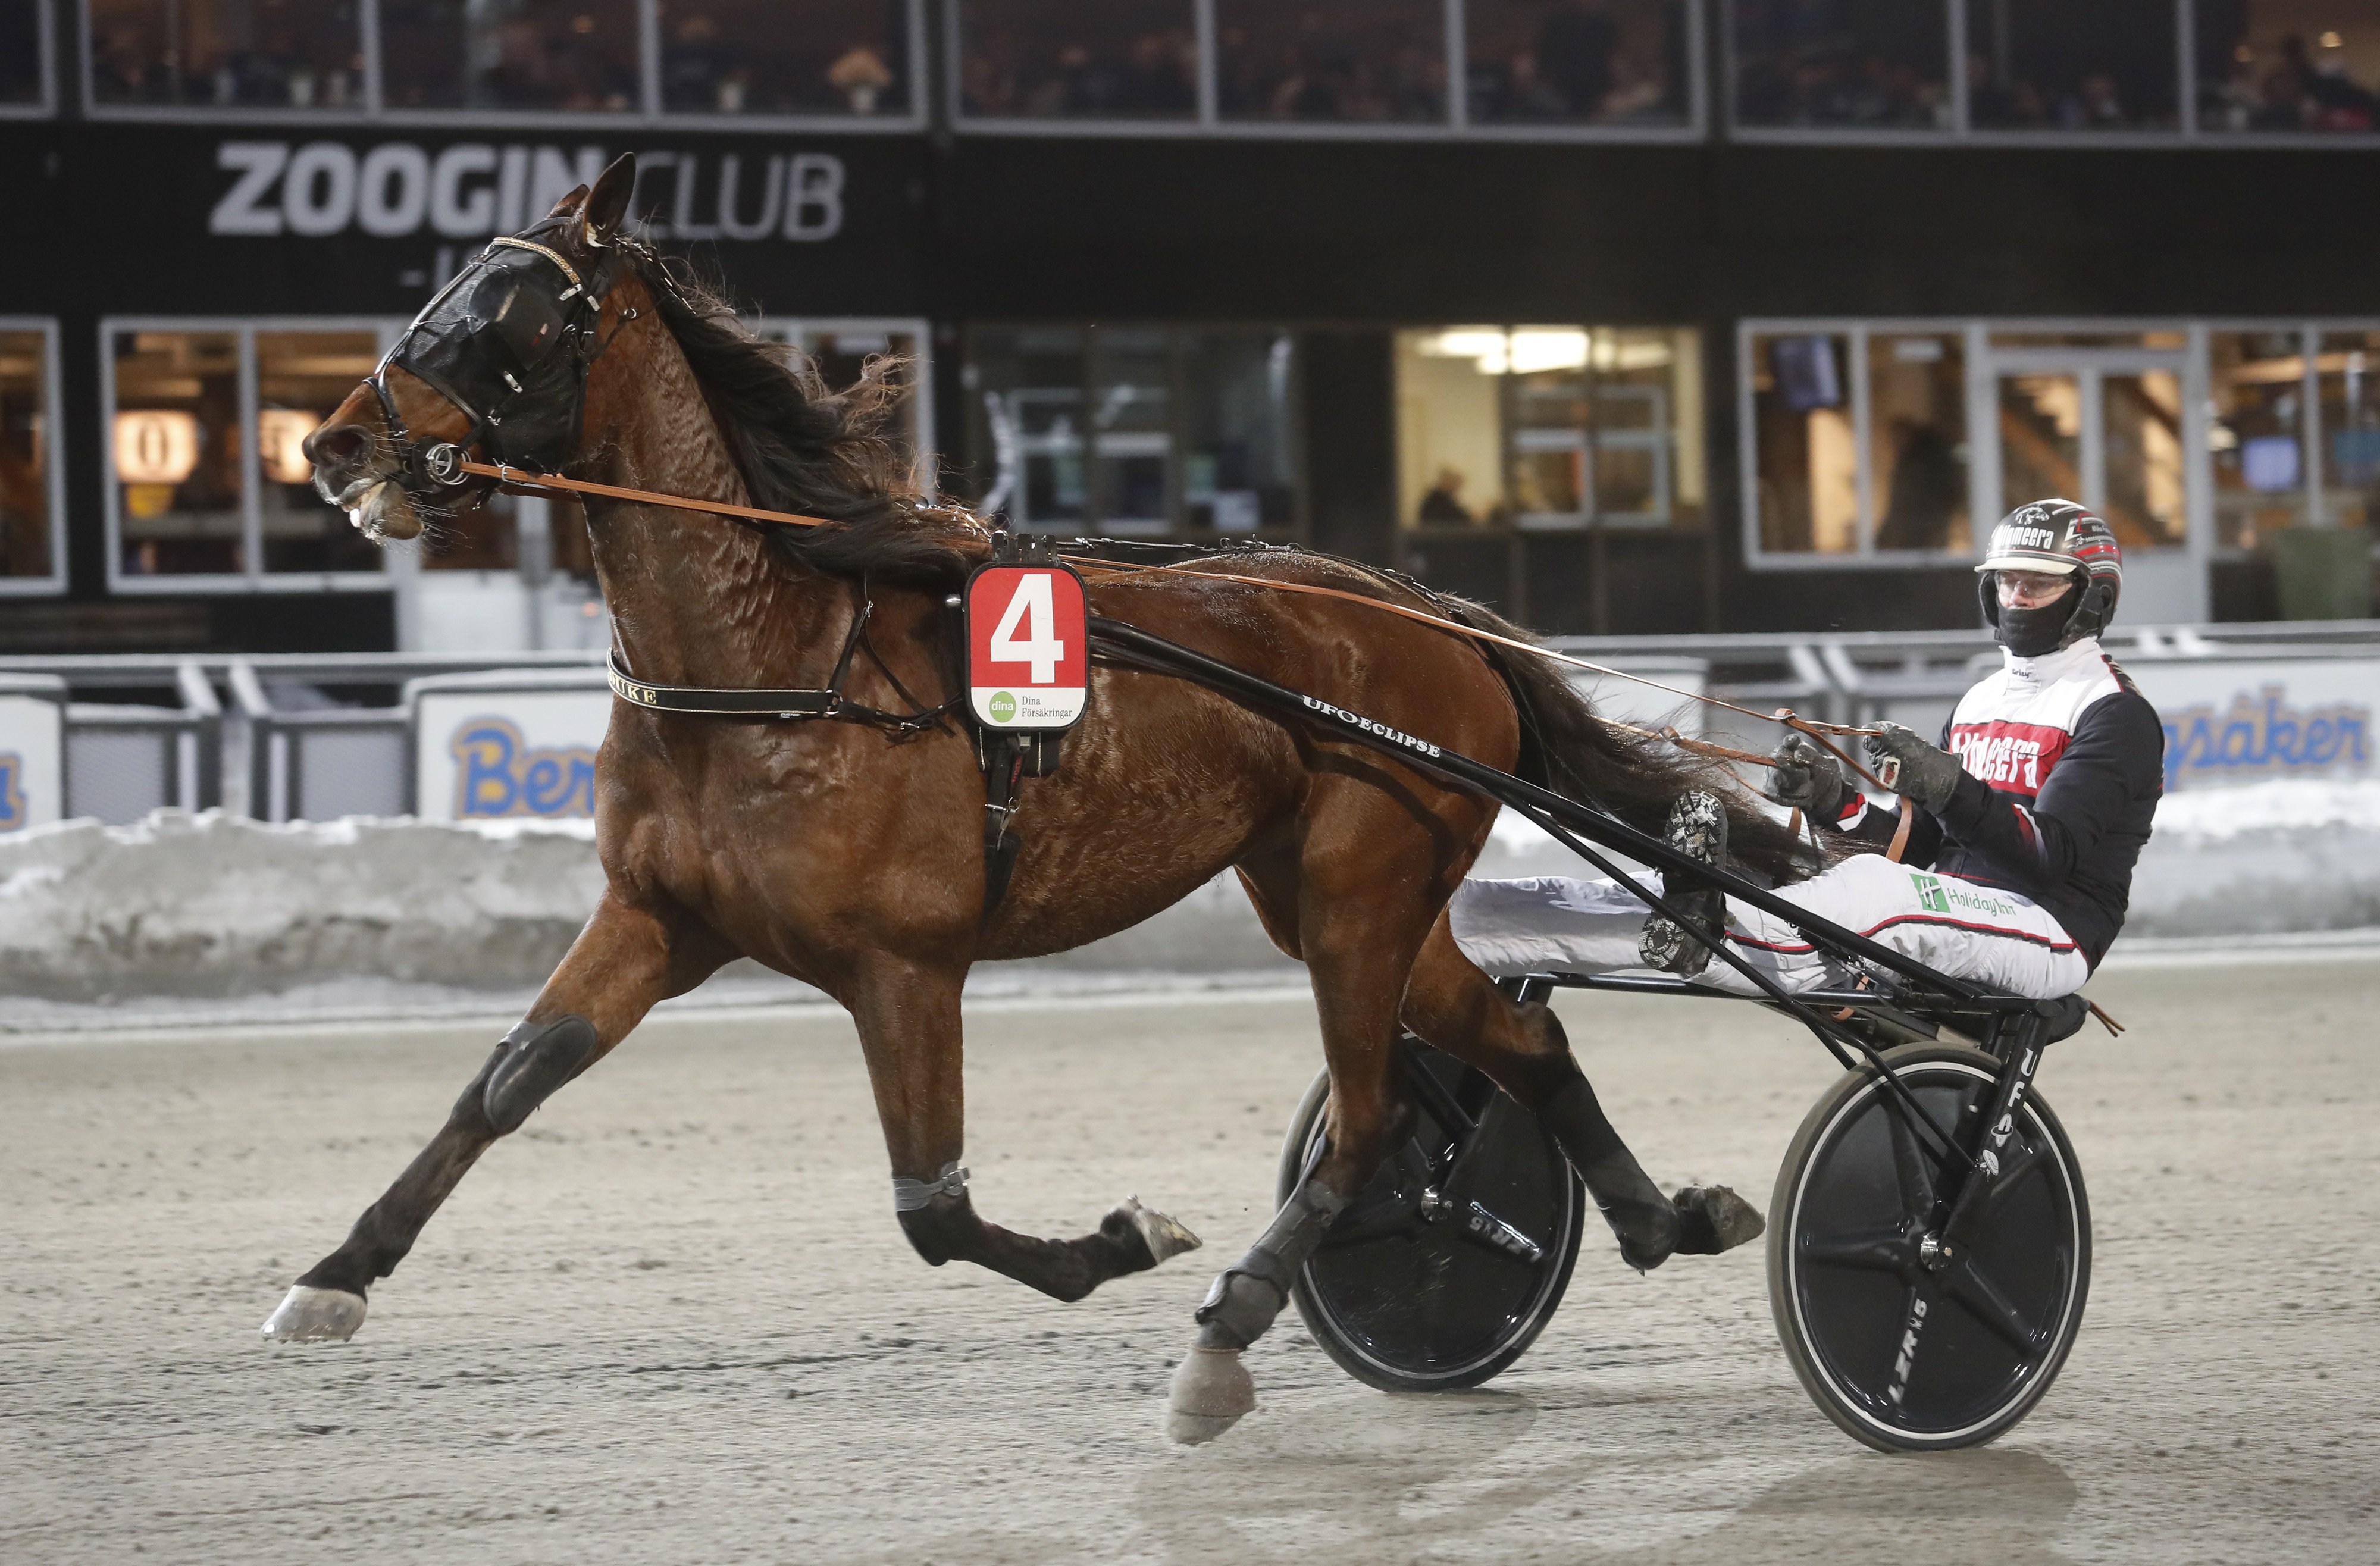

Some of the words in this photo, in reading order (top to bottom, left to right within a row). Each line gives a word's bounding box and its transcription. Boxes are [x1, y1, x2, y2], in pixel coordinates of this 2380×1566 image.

[208, 142, 598, 236] ZOOGIN
[628, 150, 846, 239] CLUB
[990, 573, 1064, 684] 4
[991, 701, 1014, 711] dina
[1022, 696, 1041, 706] Dina
[1022, 708, 1073, 718] Försäkringar
[1302, 694, 1358, 724] UFO
[1358, 718, 1441, 758] ECLIPSE
[1947, 888, 1997, 917] Holiday
[1994, 898, 2016, 916] Inn
